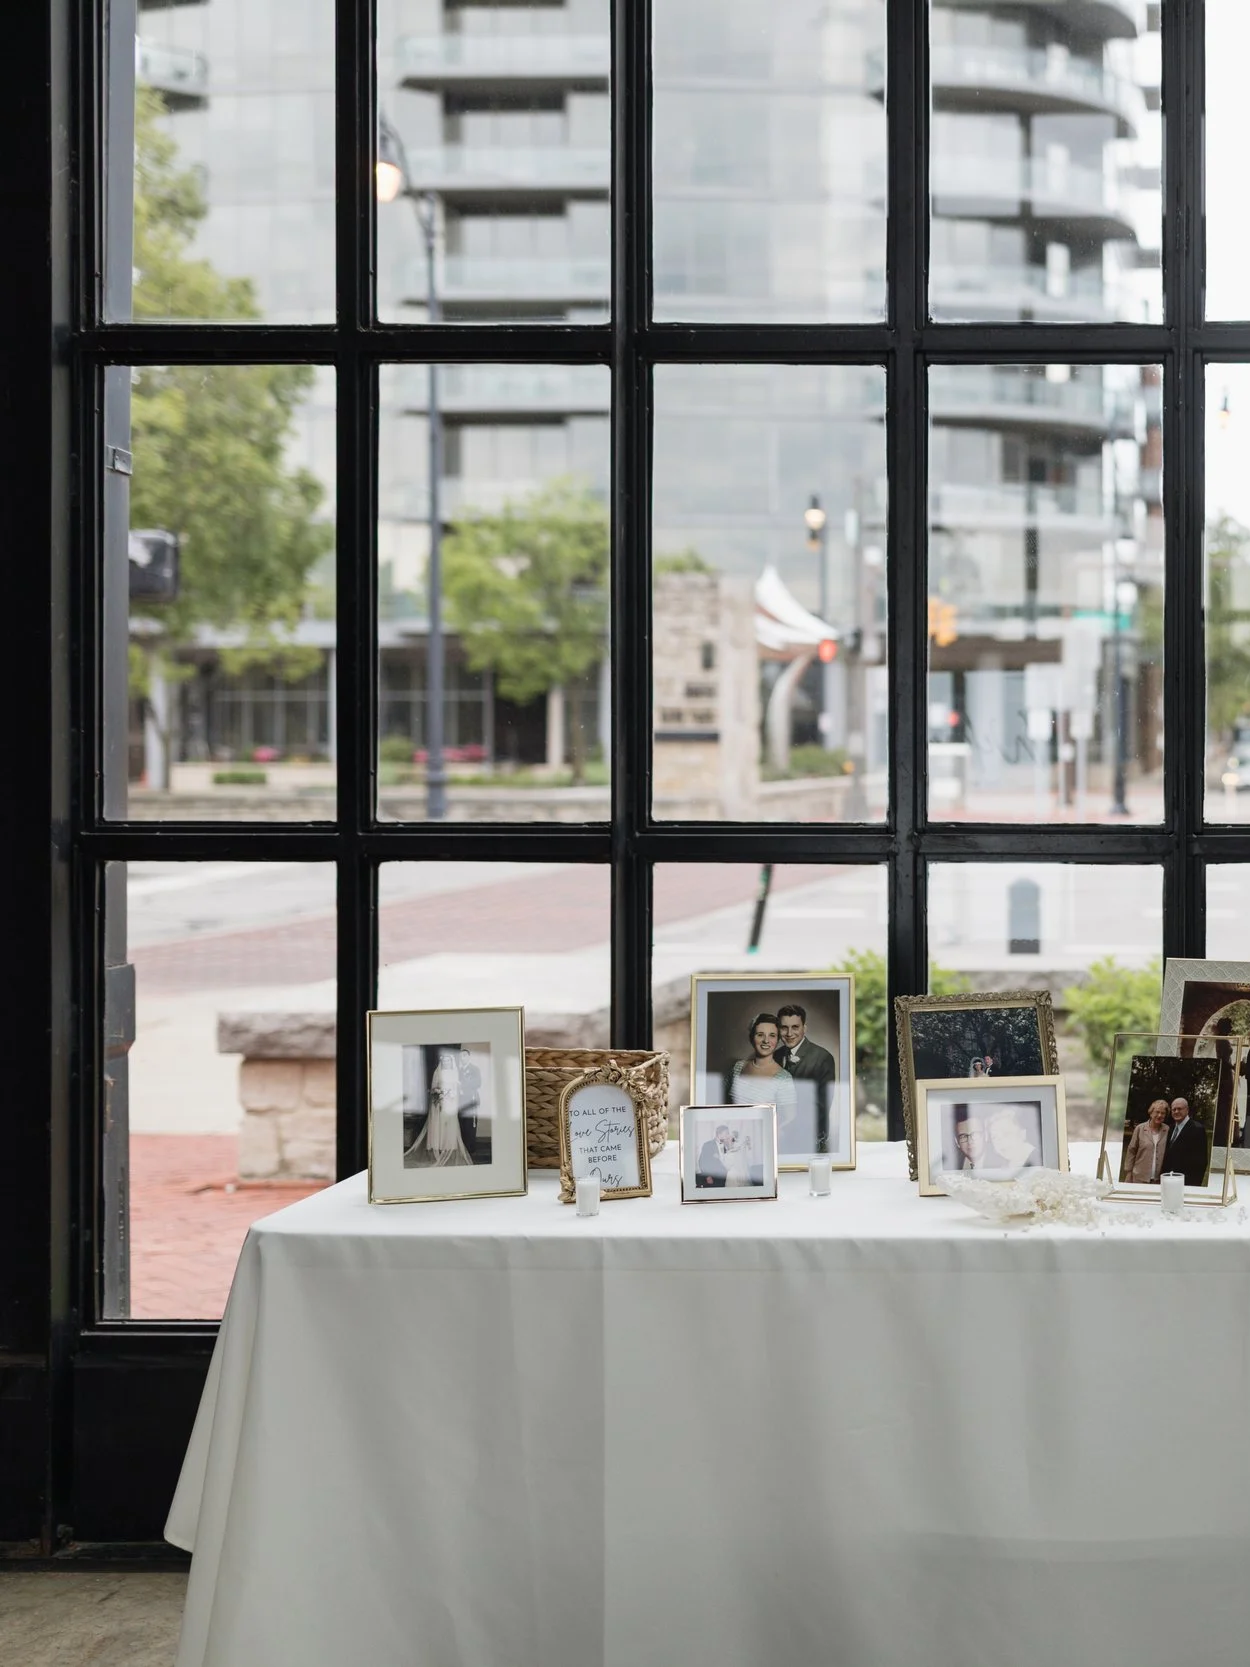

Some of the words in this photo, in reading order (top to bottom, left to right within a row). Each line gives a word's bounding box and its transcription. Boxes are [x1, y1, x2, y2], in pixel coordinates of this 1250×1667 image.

[599, 1107, 610, 1115] OF
[595, 1119, 635, 1144] Stories
[579, 1146, 598, 1154] THAT
[600, 1144, 622, 1152] CAME
[588, 1155, 617, 1163] BEFORE
